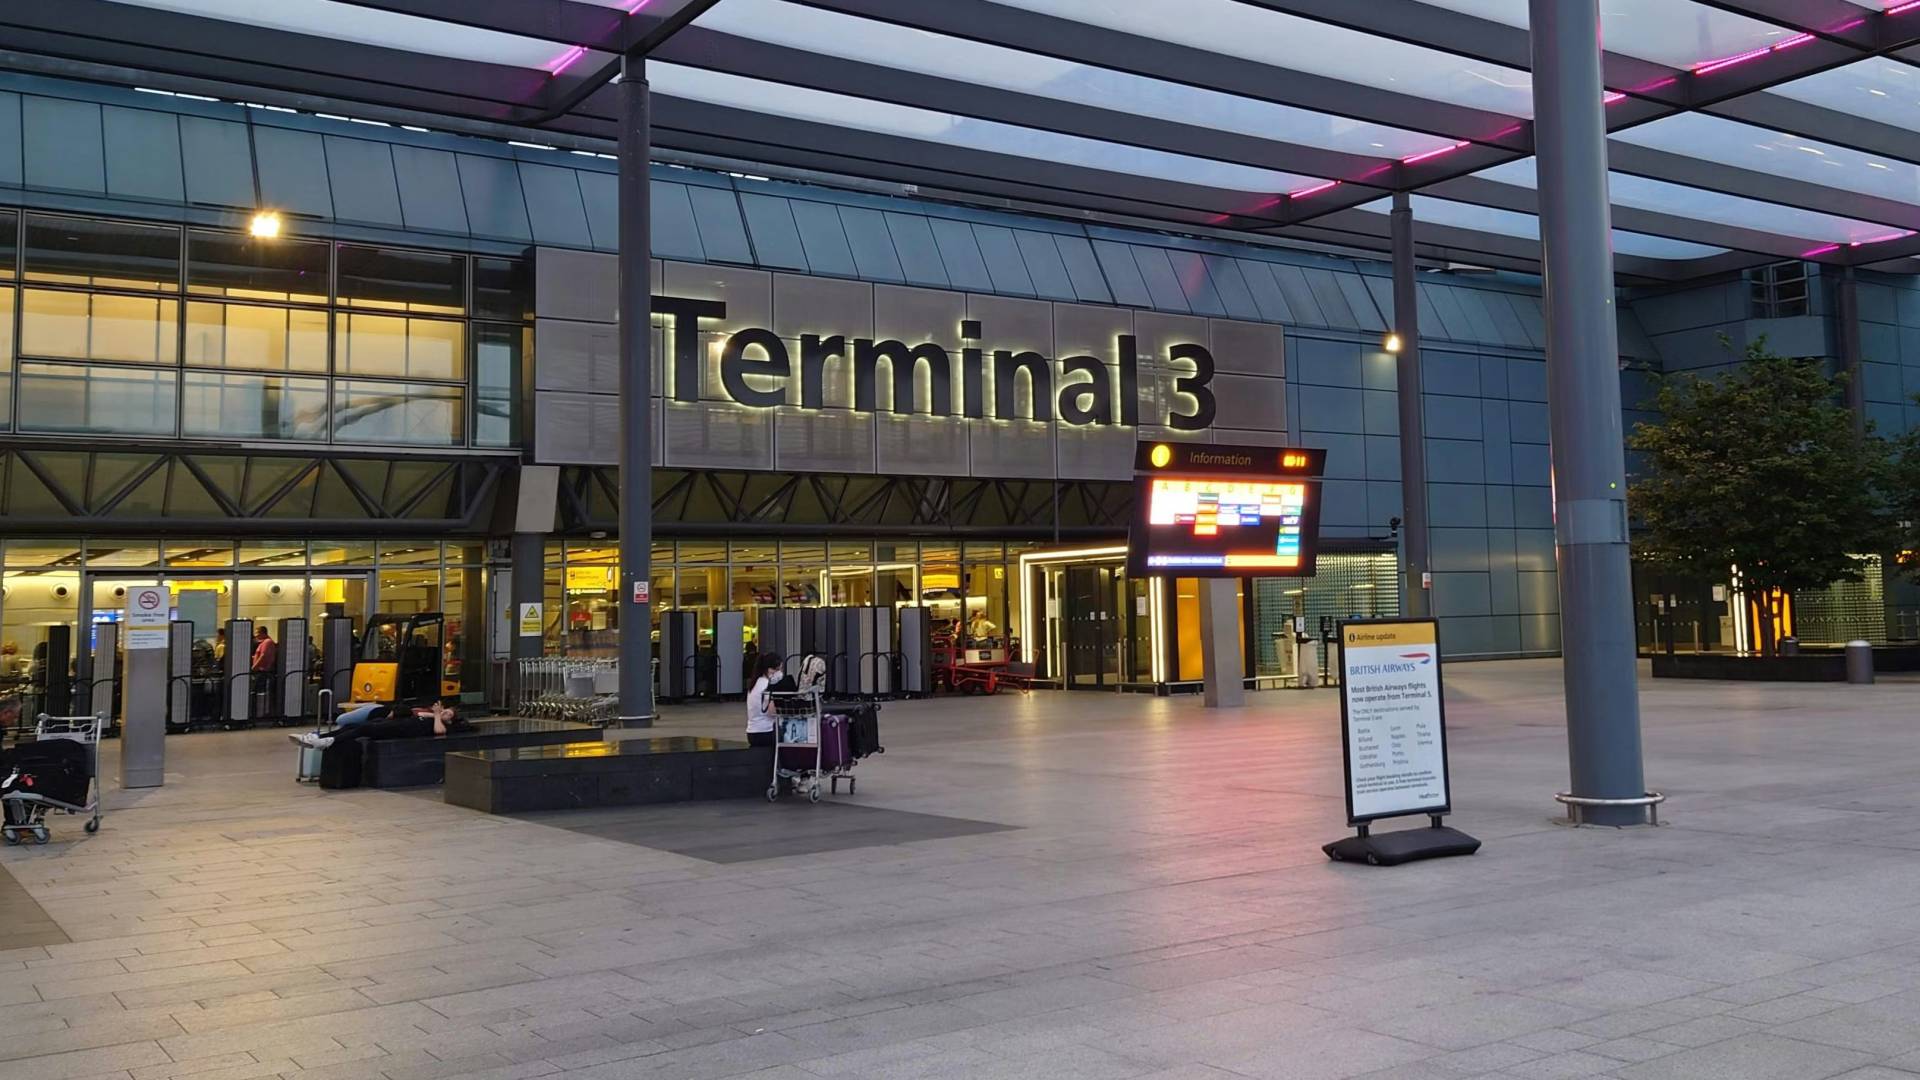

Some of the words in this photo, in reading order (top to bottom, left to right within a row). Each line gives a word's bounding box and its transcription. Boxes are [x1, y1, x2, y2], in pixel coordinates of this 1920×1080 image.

[651, 295, 1138, 427] Terminal
[1169, 343, 1216, 430] 3
[1190, 452, 1252, 466] Information
[1376, 633, 1396, 641] update
[1350, 664, 1380, 675] BRITISH
[1382, 663, 1416, 673] AIRWAYS
[1385, 684, 1407, 692] Airways
[1408, 682, 1426, 690] flights
[1365, 695, 1386, 703] operate
